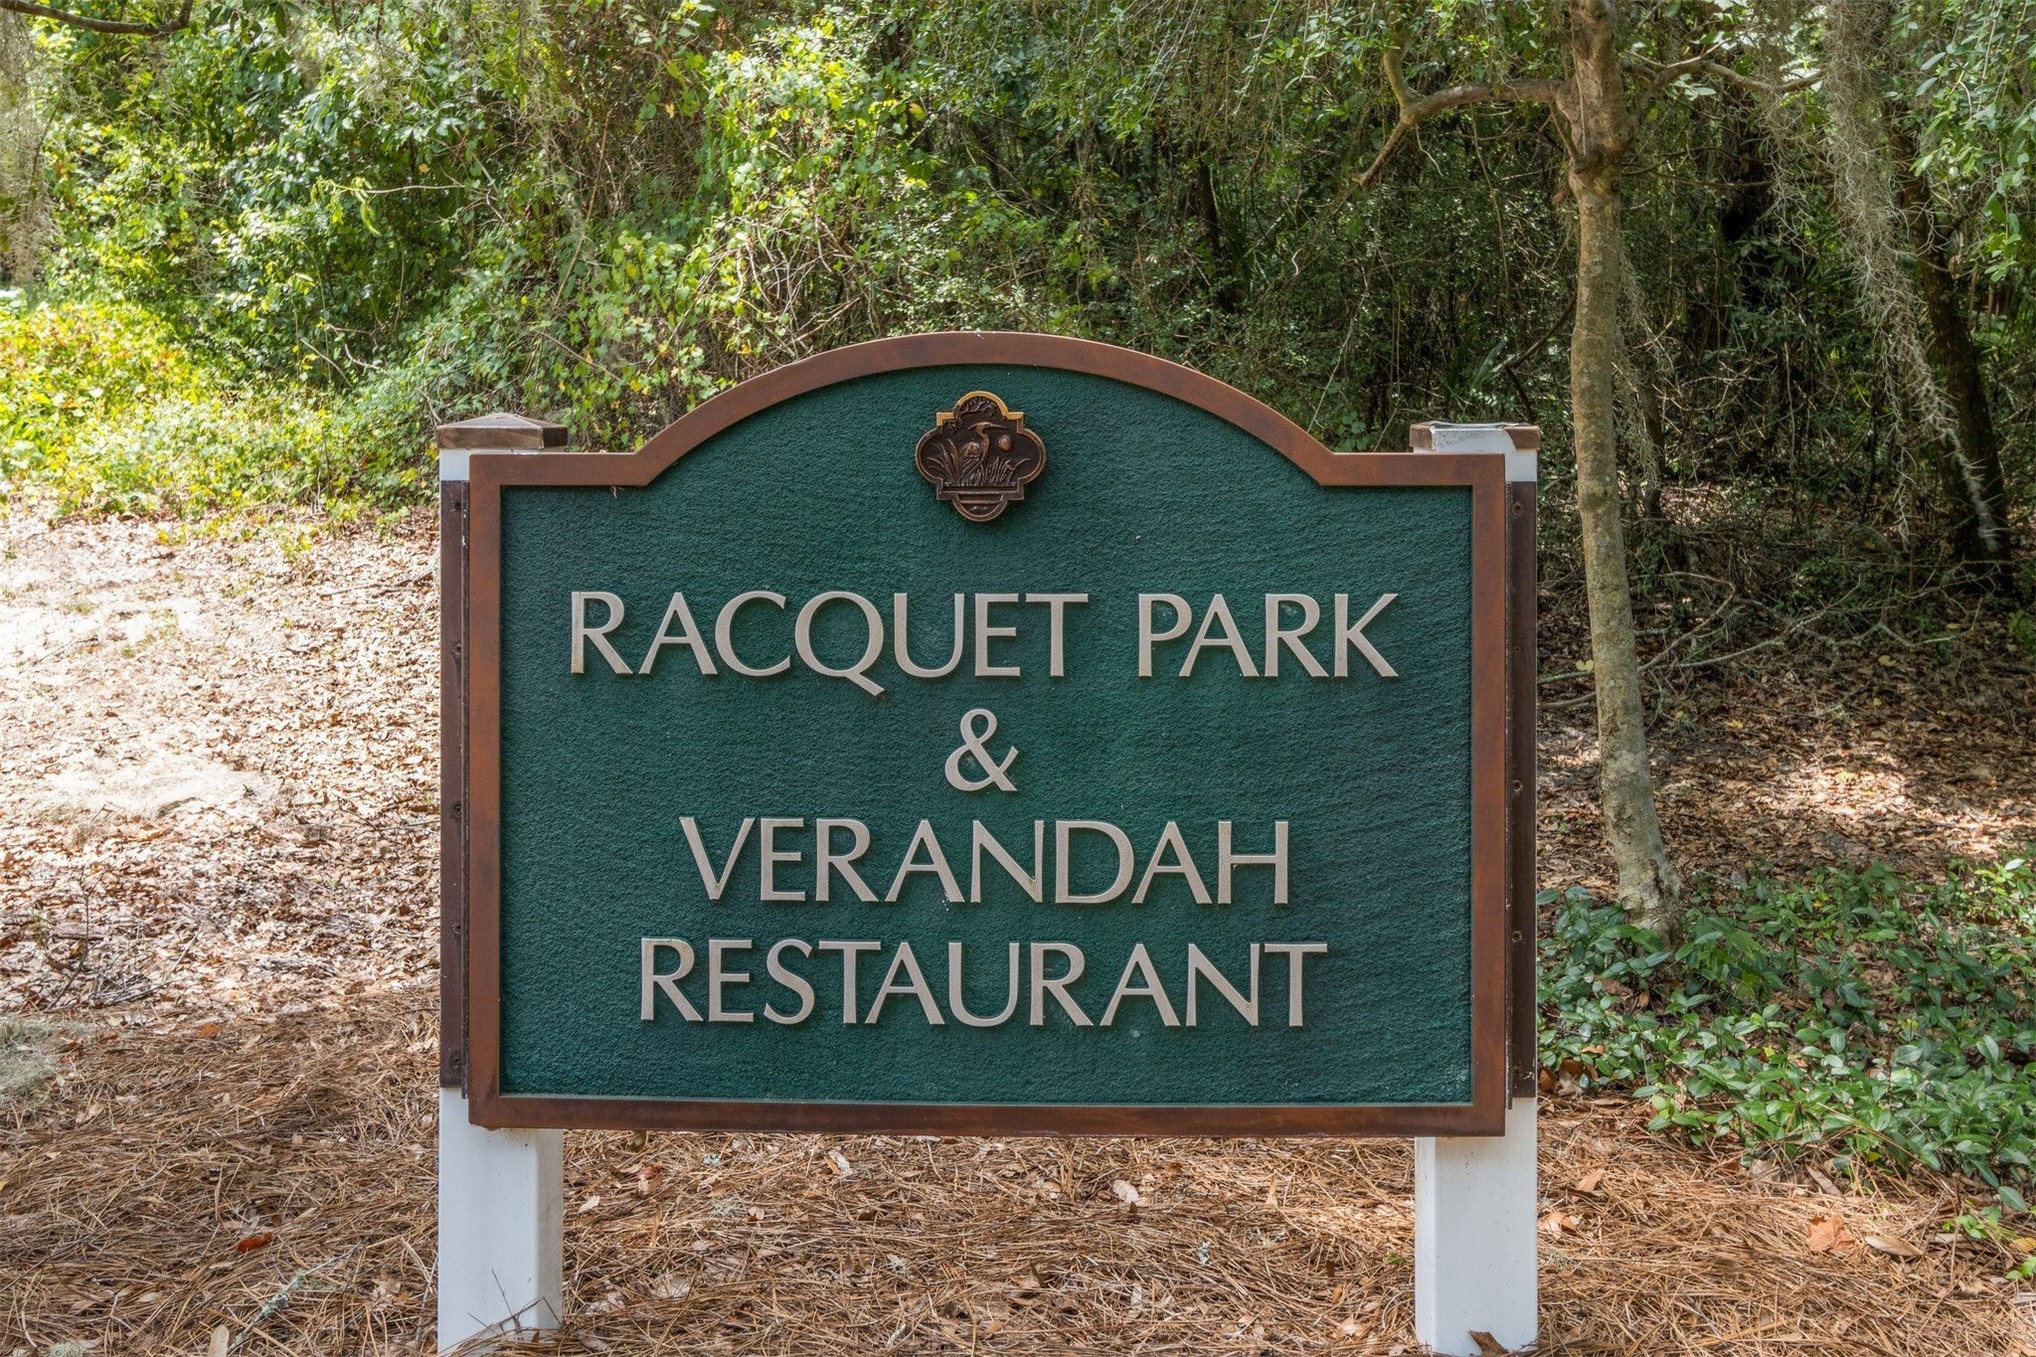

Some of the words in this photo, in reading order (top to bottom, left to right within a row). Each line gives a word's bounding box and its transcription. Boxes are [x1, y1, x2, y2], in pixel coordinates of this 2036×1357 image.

[569, 590, 1089, 697] RACQUET
[1138, 592, 1399, 678] PARK
[943, 707, 1018, 792] &
[680, 816, 1289, 905] VERANDAH
[640, 937, 1328, 1027] RESTAURANT
